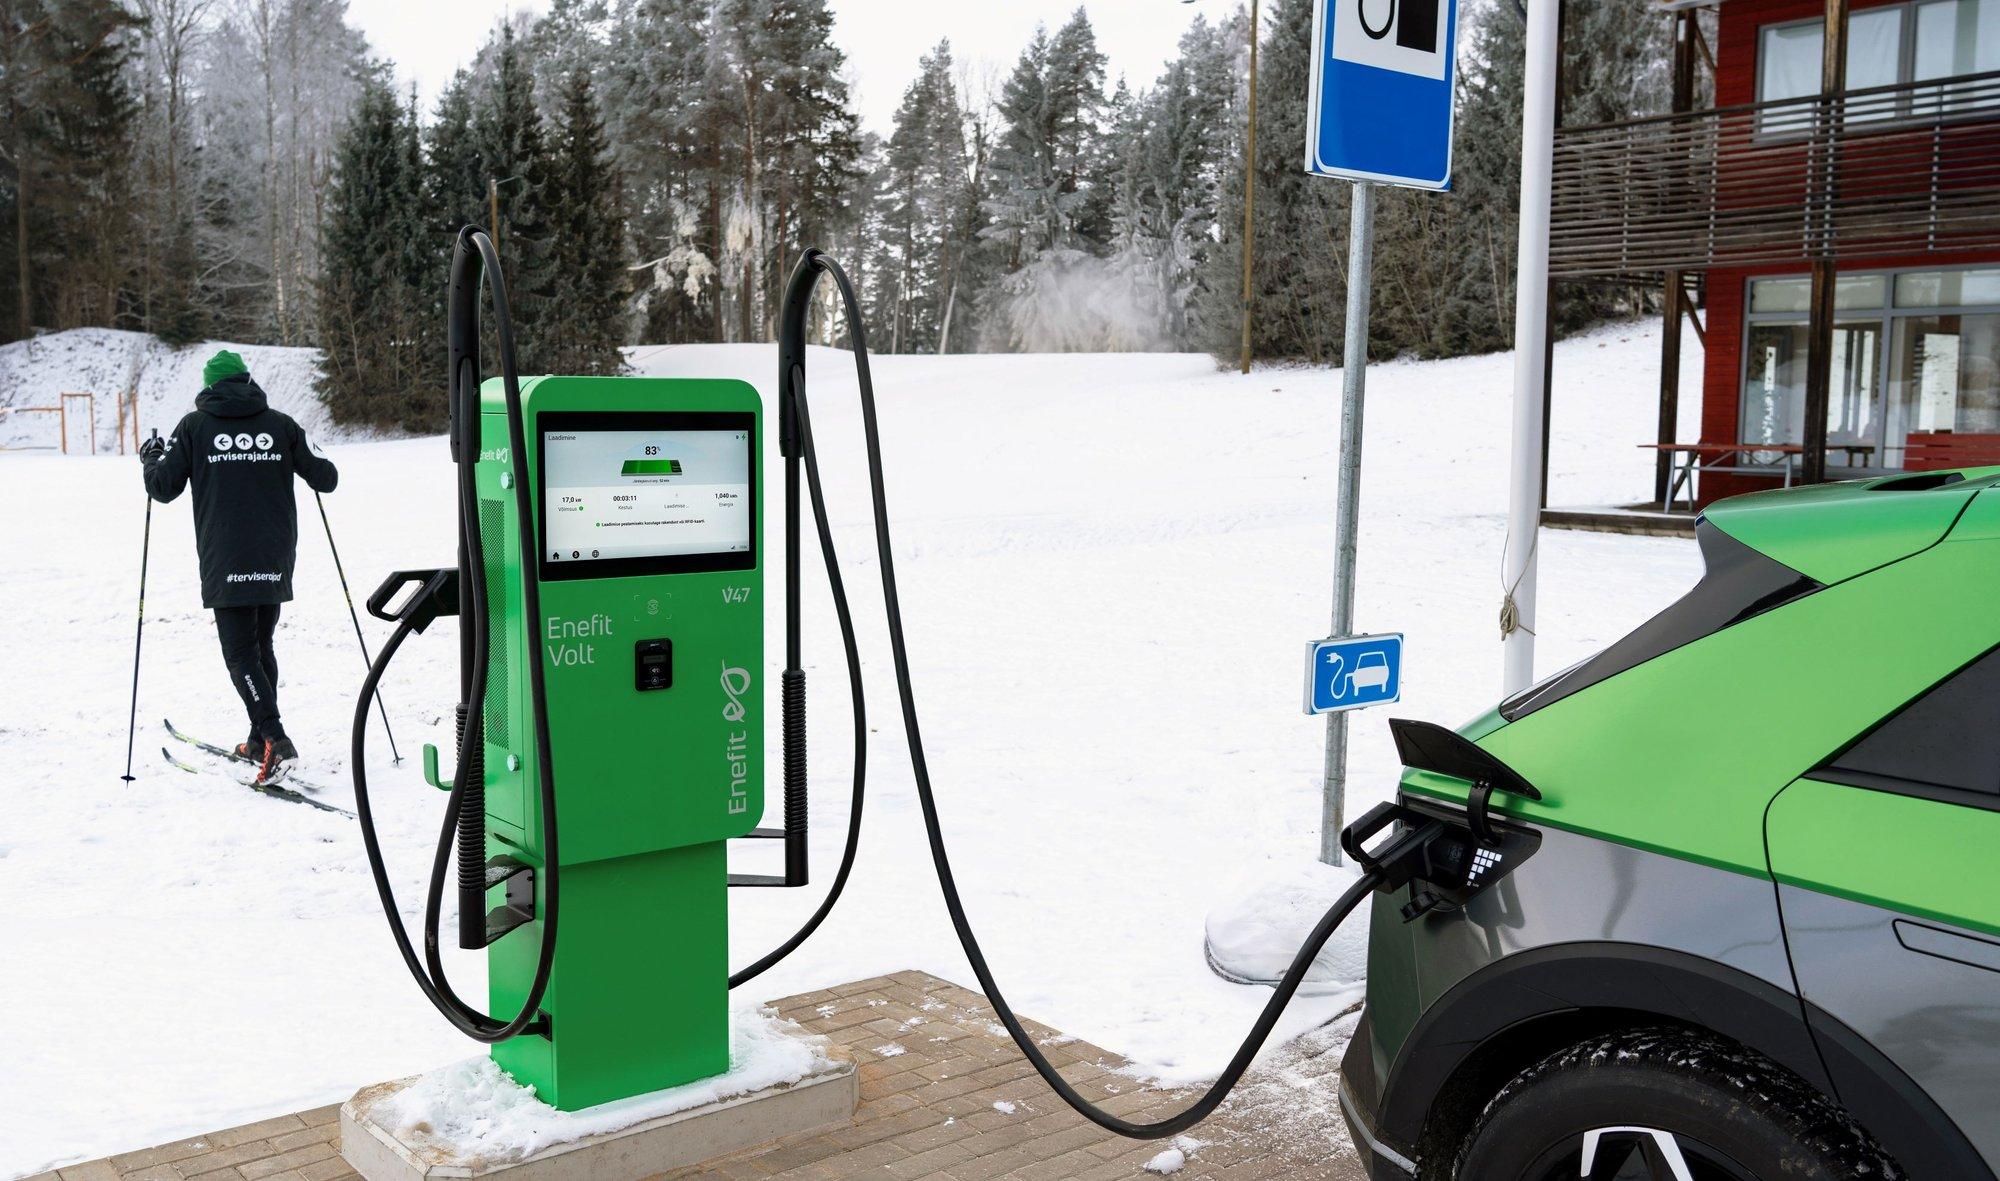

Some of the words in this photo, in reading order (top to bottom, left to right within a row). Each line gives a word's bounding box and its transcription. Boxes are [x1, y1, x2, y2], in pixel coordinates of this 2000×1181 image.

[207, 451, 282, 463] terviserajad.ee
[721, 586, 751, 603] V47
[547, 613, 613, 639] Enefit
[548, 643, 595, 667] Volt
[727, 730, 747, 814] Enefit
